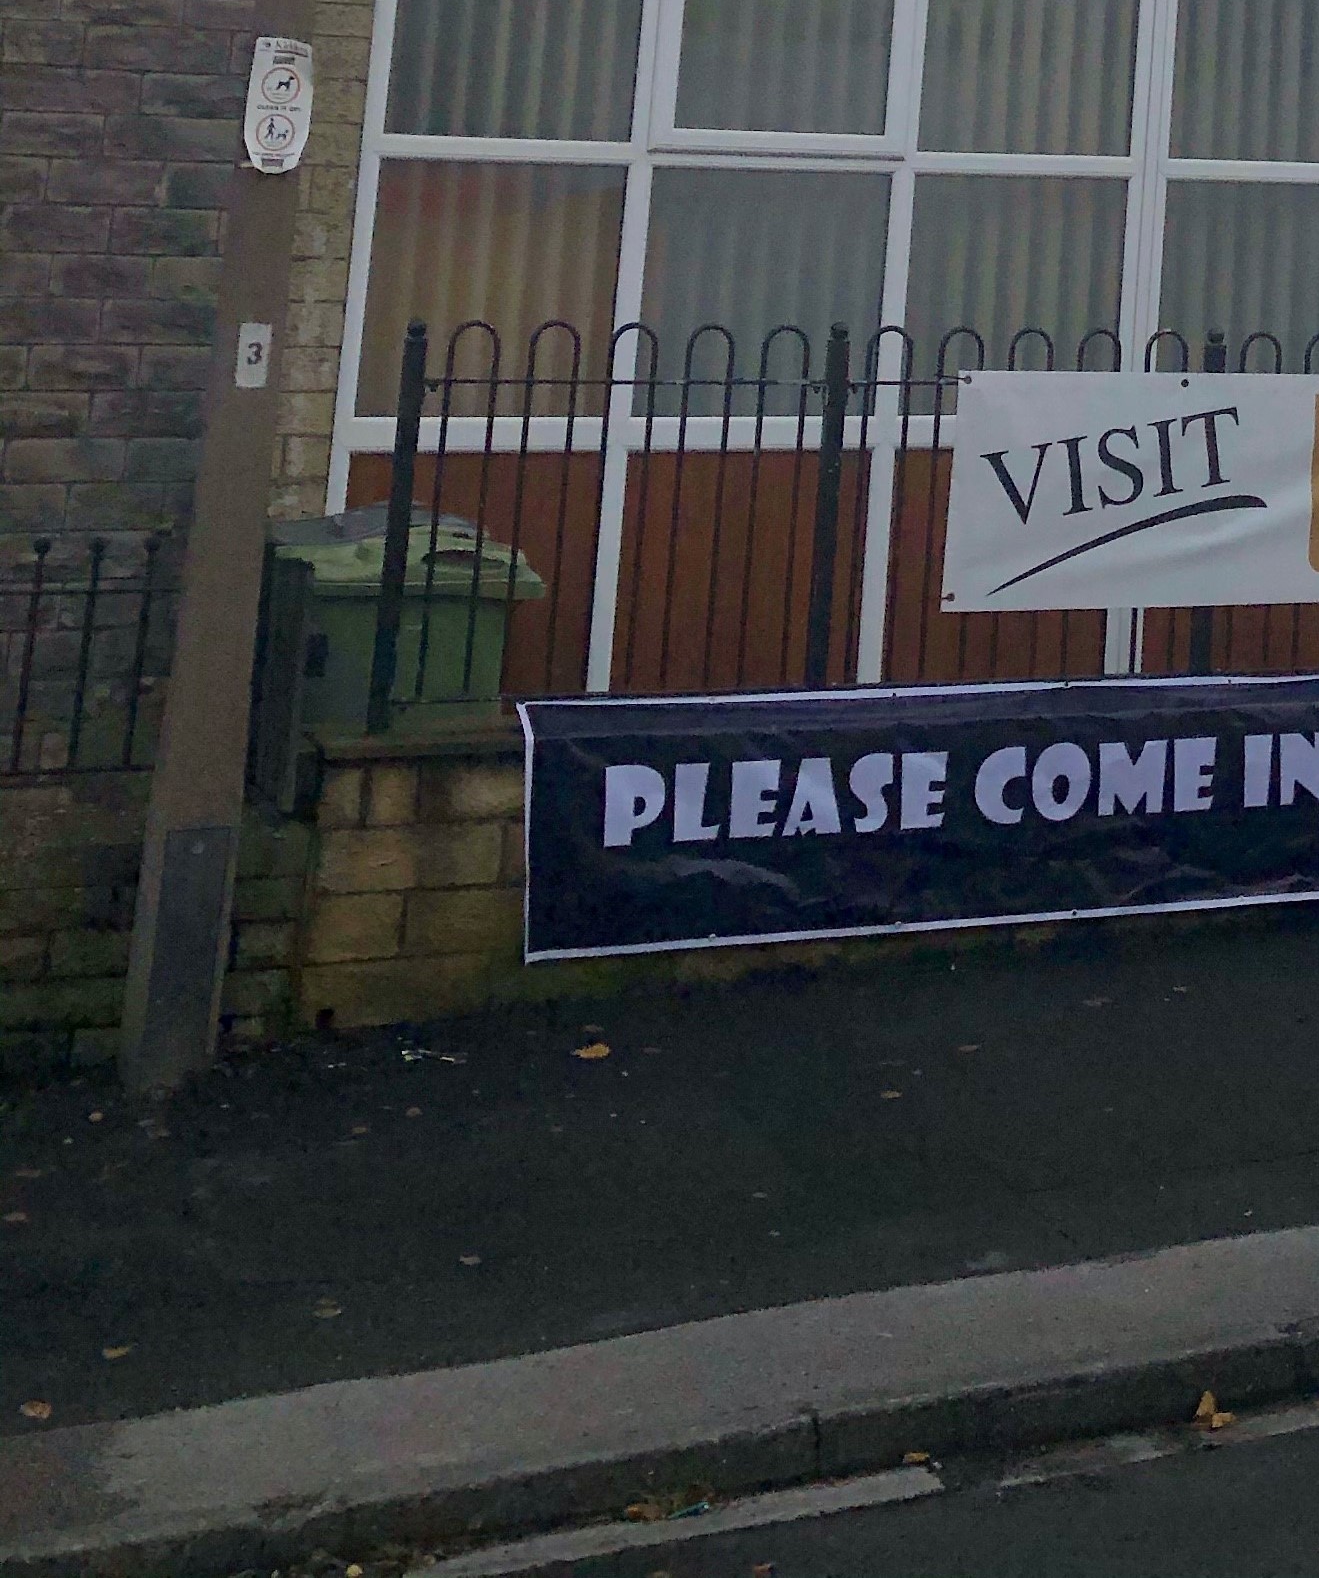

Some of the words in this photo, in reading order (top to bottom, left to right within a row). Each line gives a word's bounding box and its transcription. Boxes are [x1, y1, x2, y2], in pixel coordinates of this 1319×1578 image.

[246, 342, 263, 365] 3
[979, 406, 1239, 525] VISIT
[602, 750, 949, 849] PLEASE
[974, 733, 1217, 826] COME
